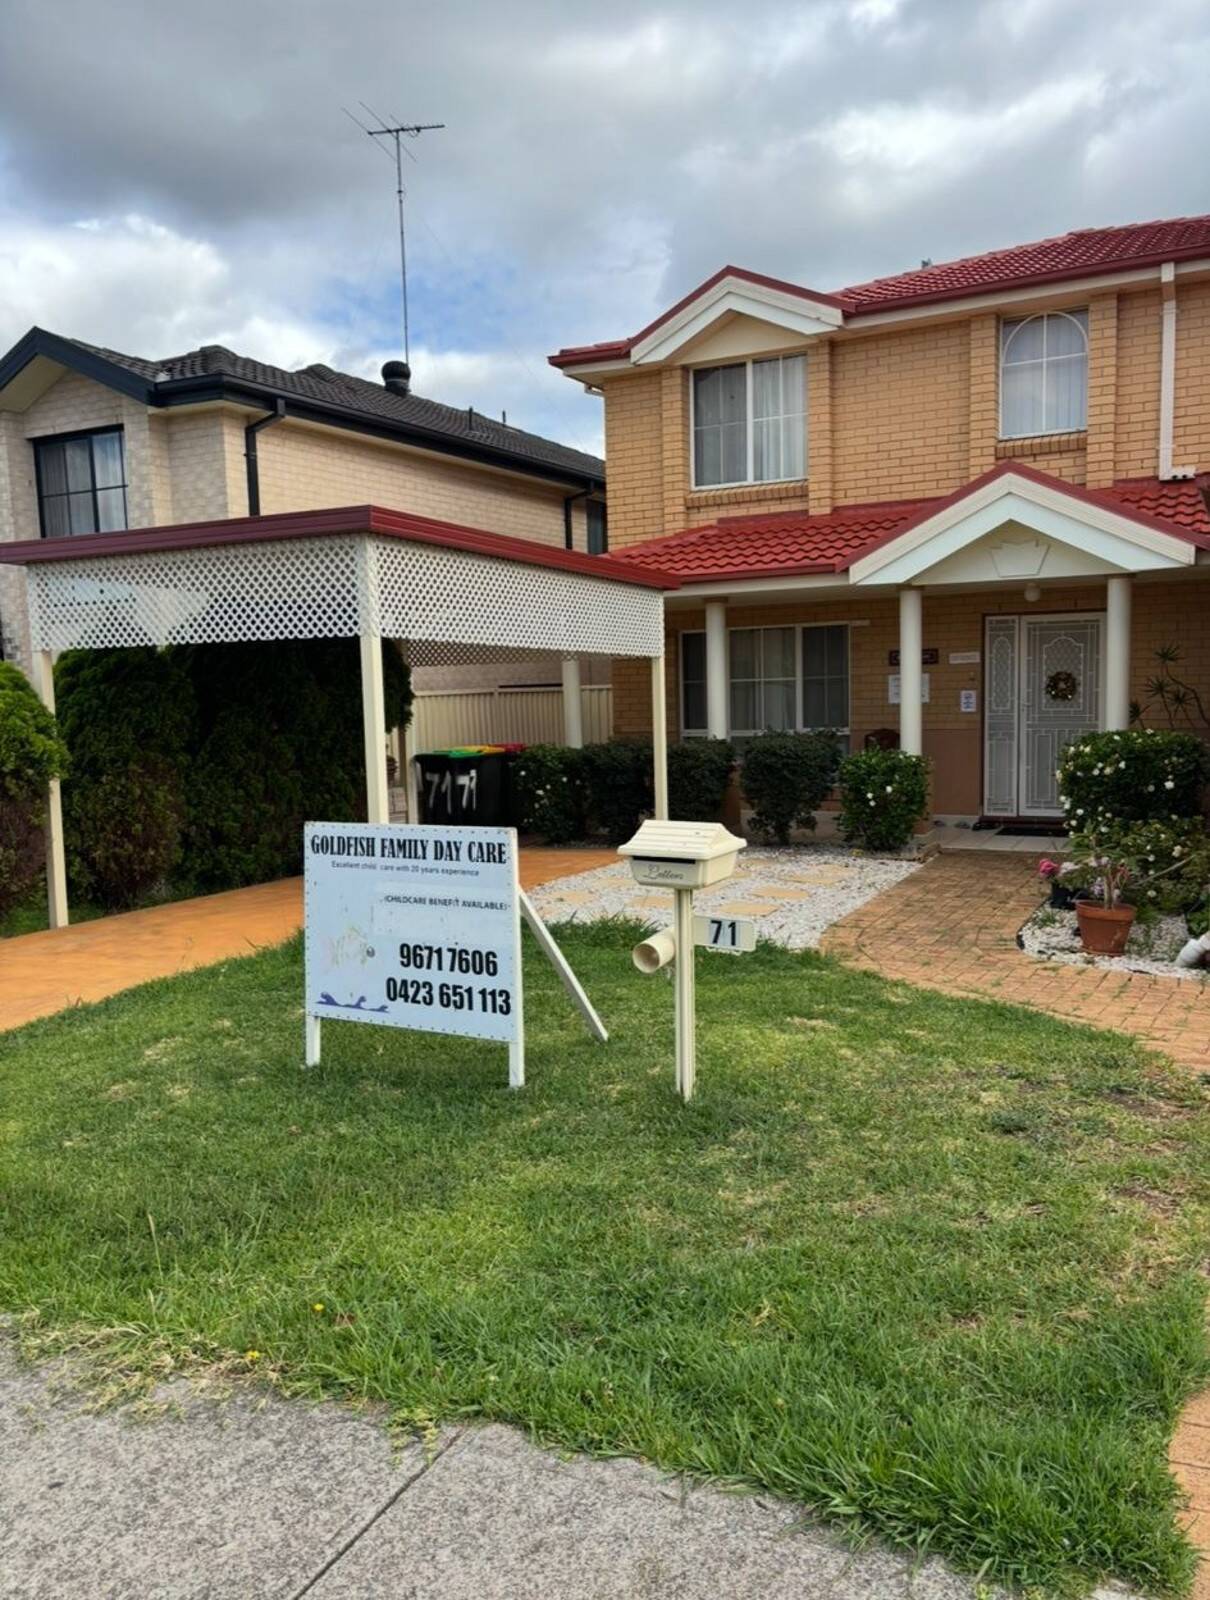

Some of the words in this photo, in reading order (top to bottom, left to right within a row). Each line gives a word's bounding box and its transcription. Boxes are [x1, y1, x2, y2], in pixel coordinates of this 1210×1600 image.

[310, 834, 376, 857] GOLDFISH
[380, 838, 429, 860] FAMILY
[433, 840, 462, 862] DAY
[467, 841, 507, 864] CARE
[331, 860, 360, 870] Excellent
[396, 864, 410, 872] with
[411, 865, 419, 873] 20
[421, 867, 439, 875] years
[441, 867, 480, 877] experience
[428, 897, 459, 907] BENEFIT
[710, 920, 737, 946] 71
[399, 943, 443, 971] 9671
[447, 947, 498, 977] 7606
[386, 977, 434, 1006] 0423
[439, 983, 473, 1011] 651
[477, 987, 511, 1016] 113
